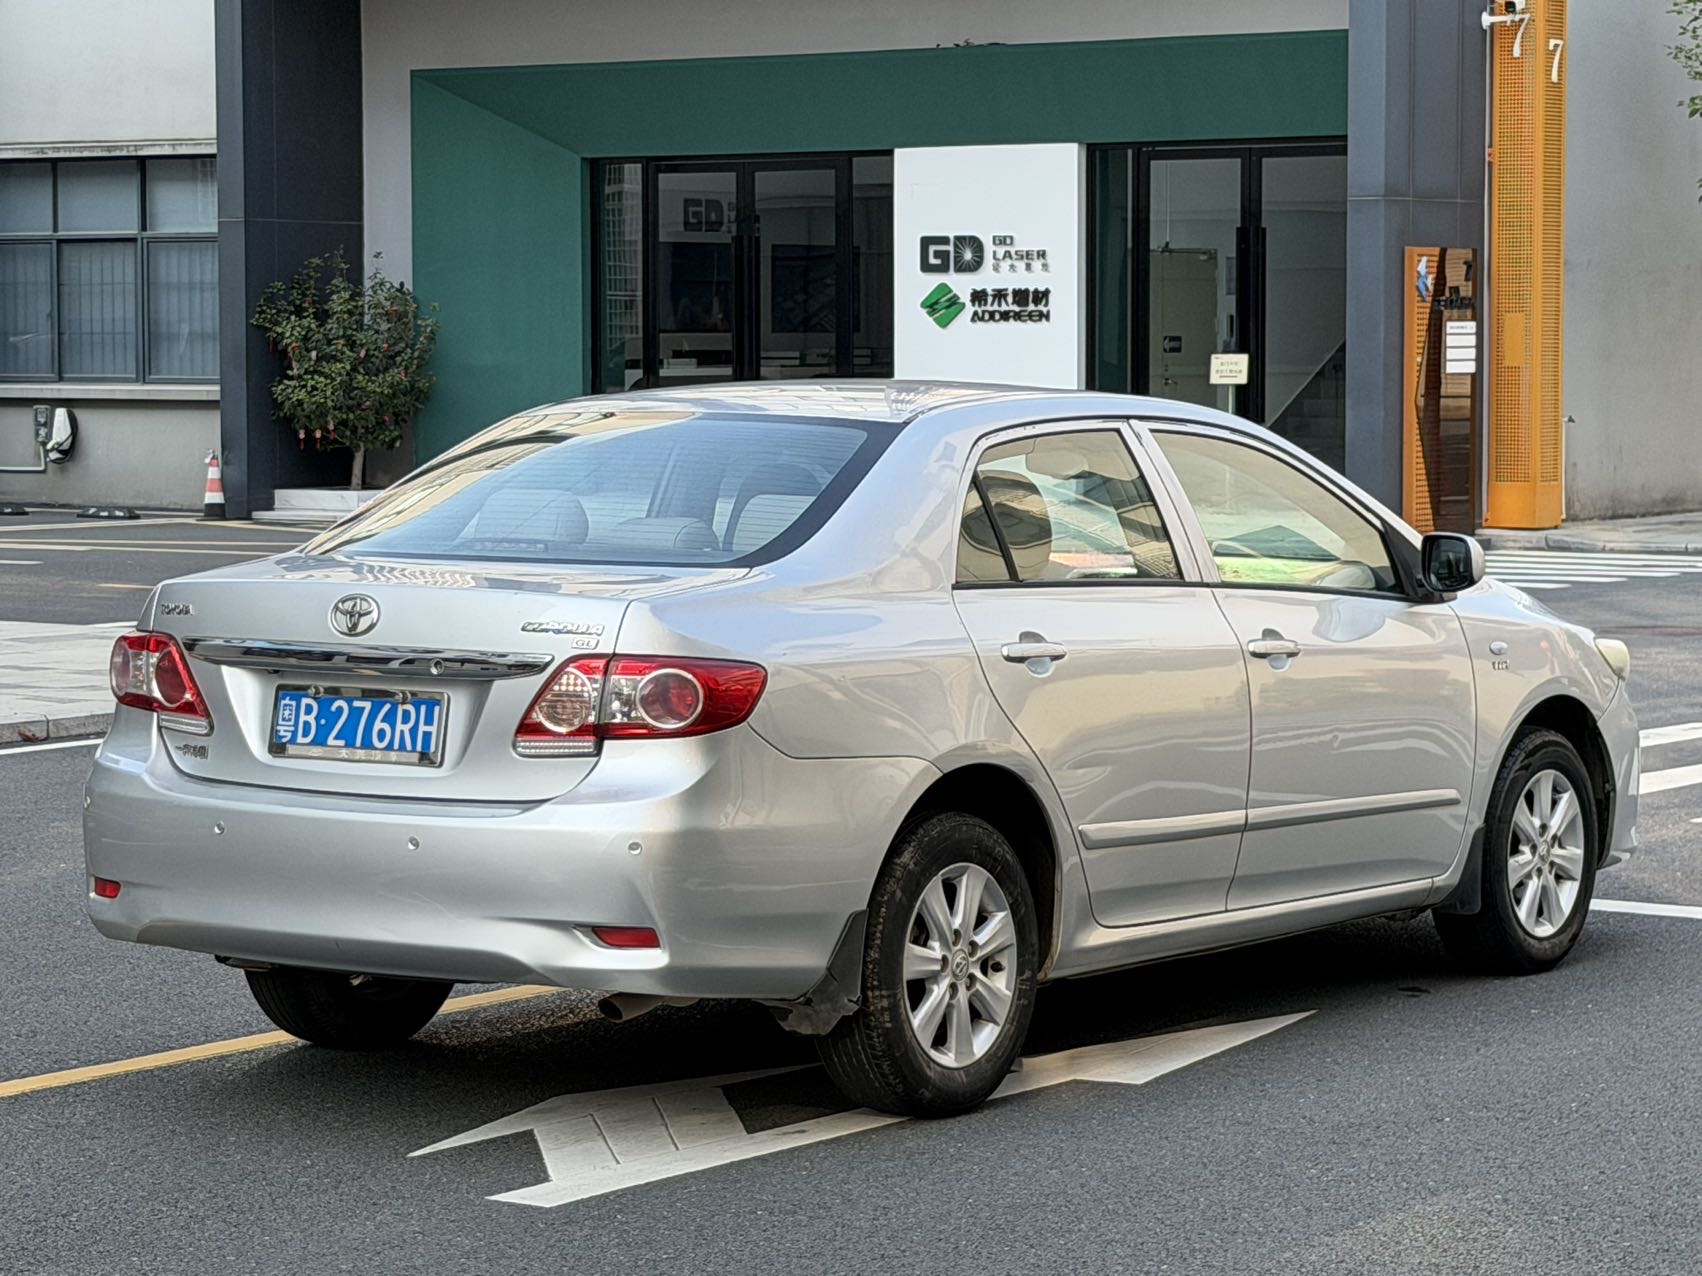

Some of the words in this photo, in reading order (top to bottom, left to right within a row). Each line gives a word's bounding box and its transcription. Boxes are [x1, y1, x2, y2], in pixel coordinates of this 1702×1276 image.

[1512, 13, 1531, 58] 7
[1549, 38, 1564, 83] 7
[920, 235, 984, 273] GD
[992, 235, 1014, 246] GD
[992, 249, 1047, 261] LASER
[276, 696, 441, 754] 粤B·276RH
